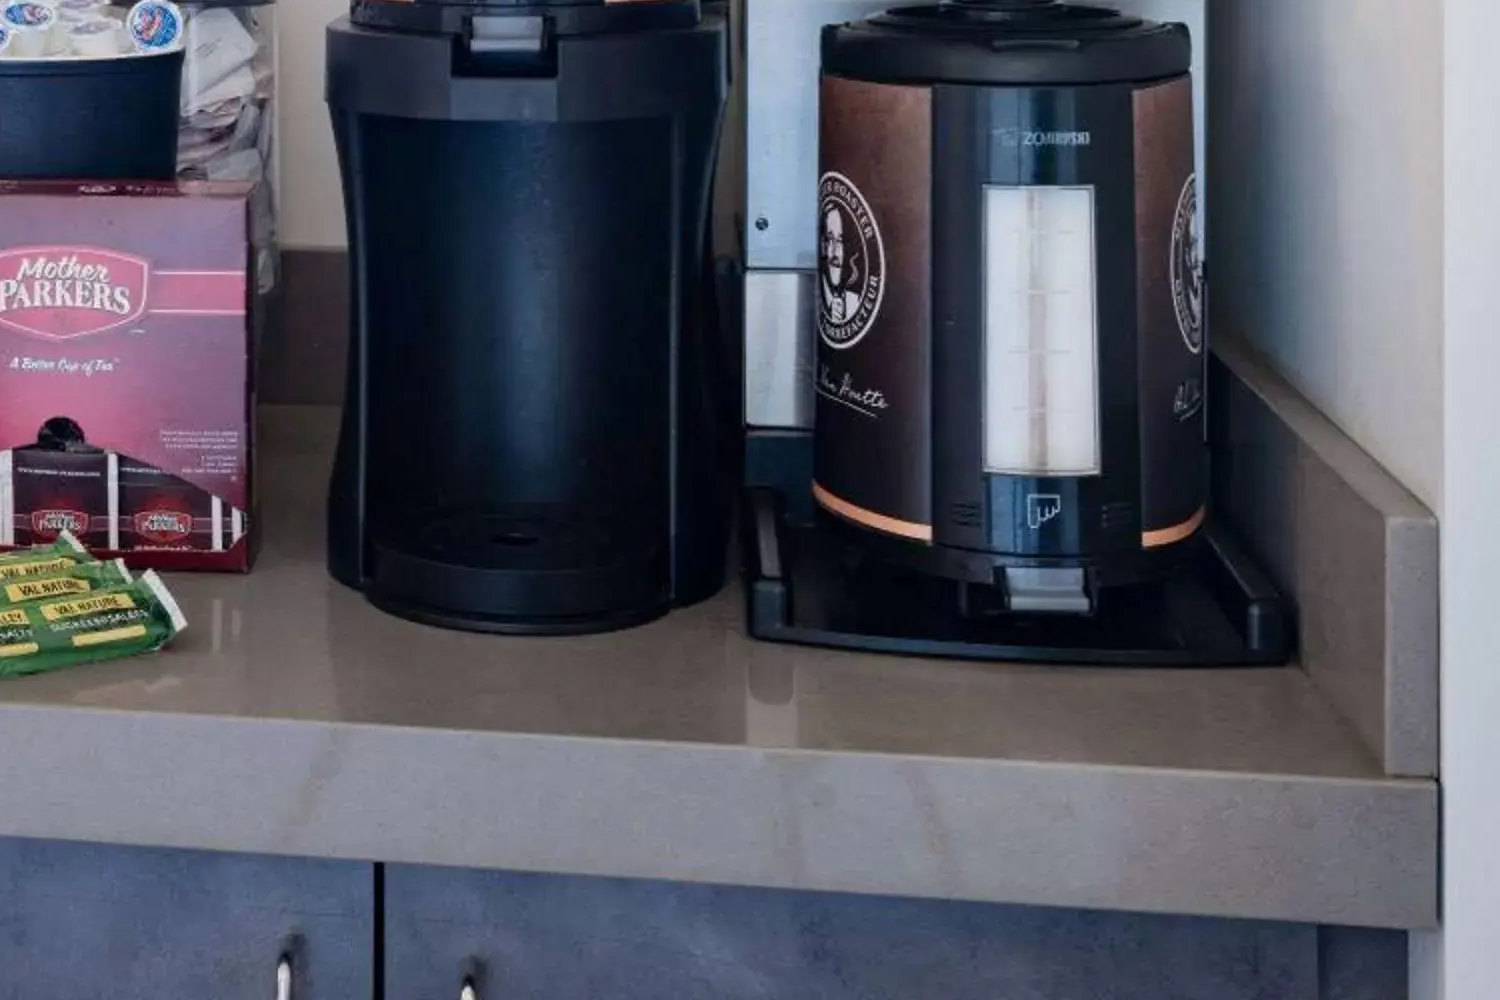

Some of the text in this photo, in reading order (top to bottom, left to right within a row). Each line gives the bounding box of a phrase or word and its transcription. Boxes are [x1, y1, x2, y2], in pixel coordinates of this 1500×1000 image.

[16, 256, 109, 282] Mother
[18, 584, 41, 597] VAL
[53, 596, 122, 615] VAL NATURE
